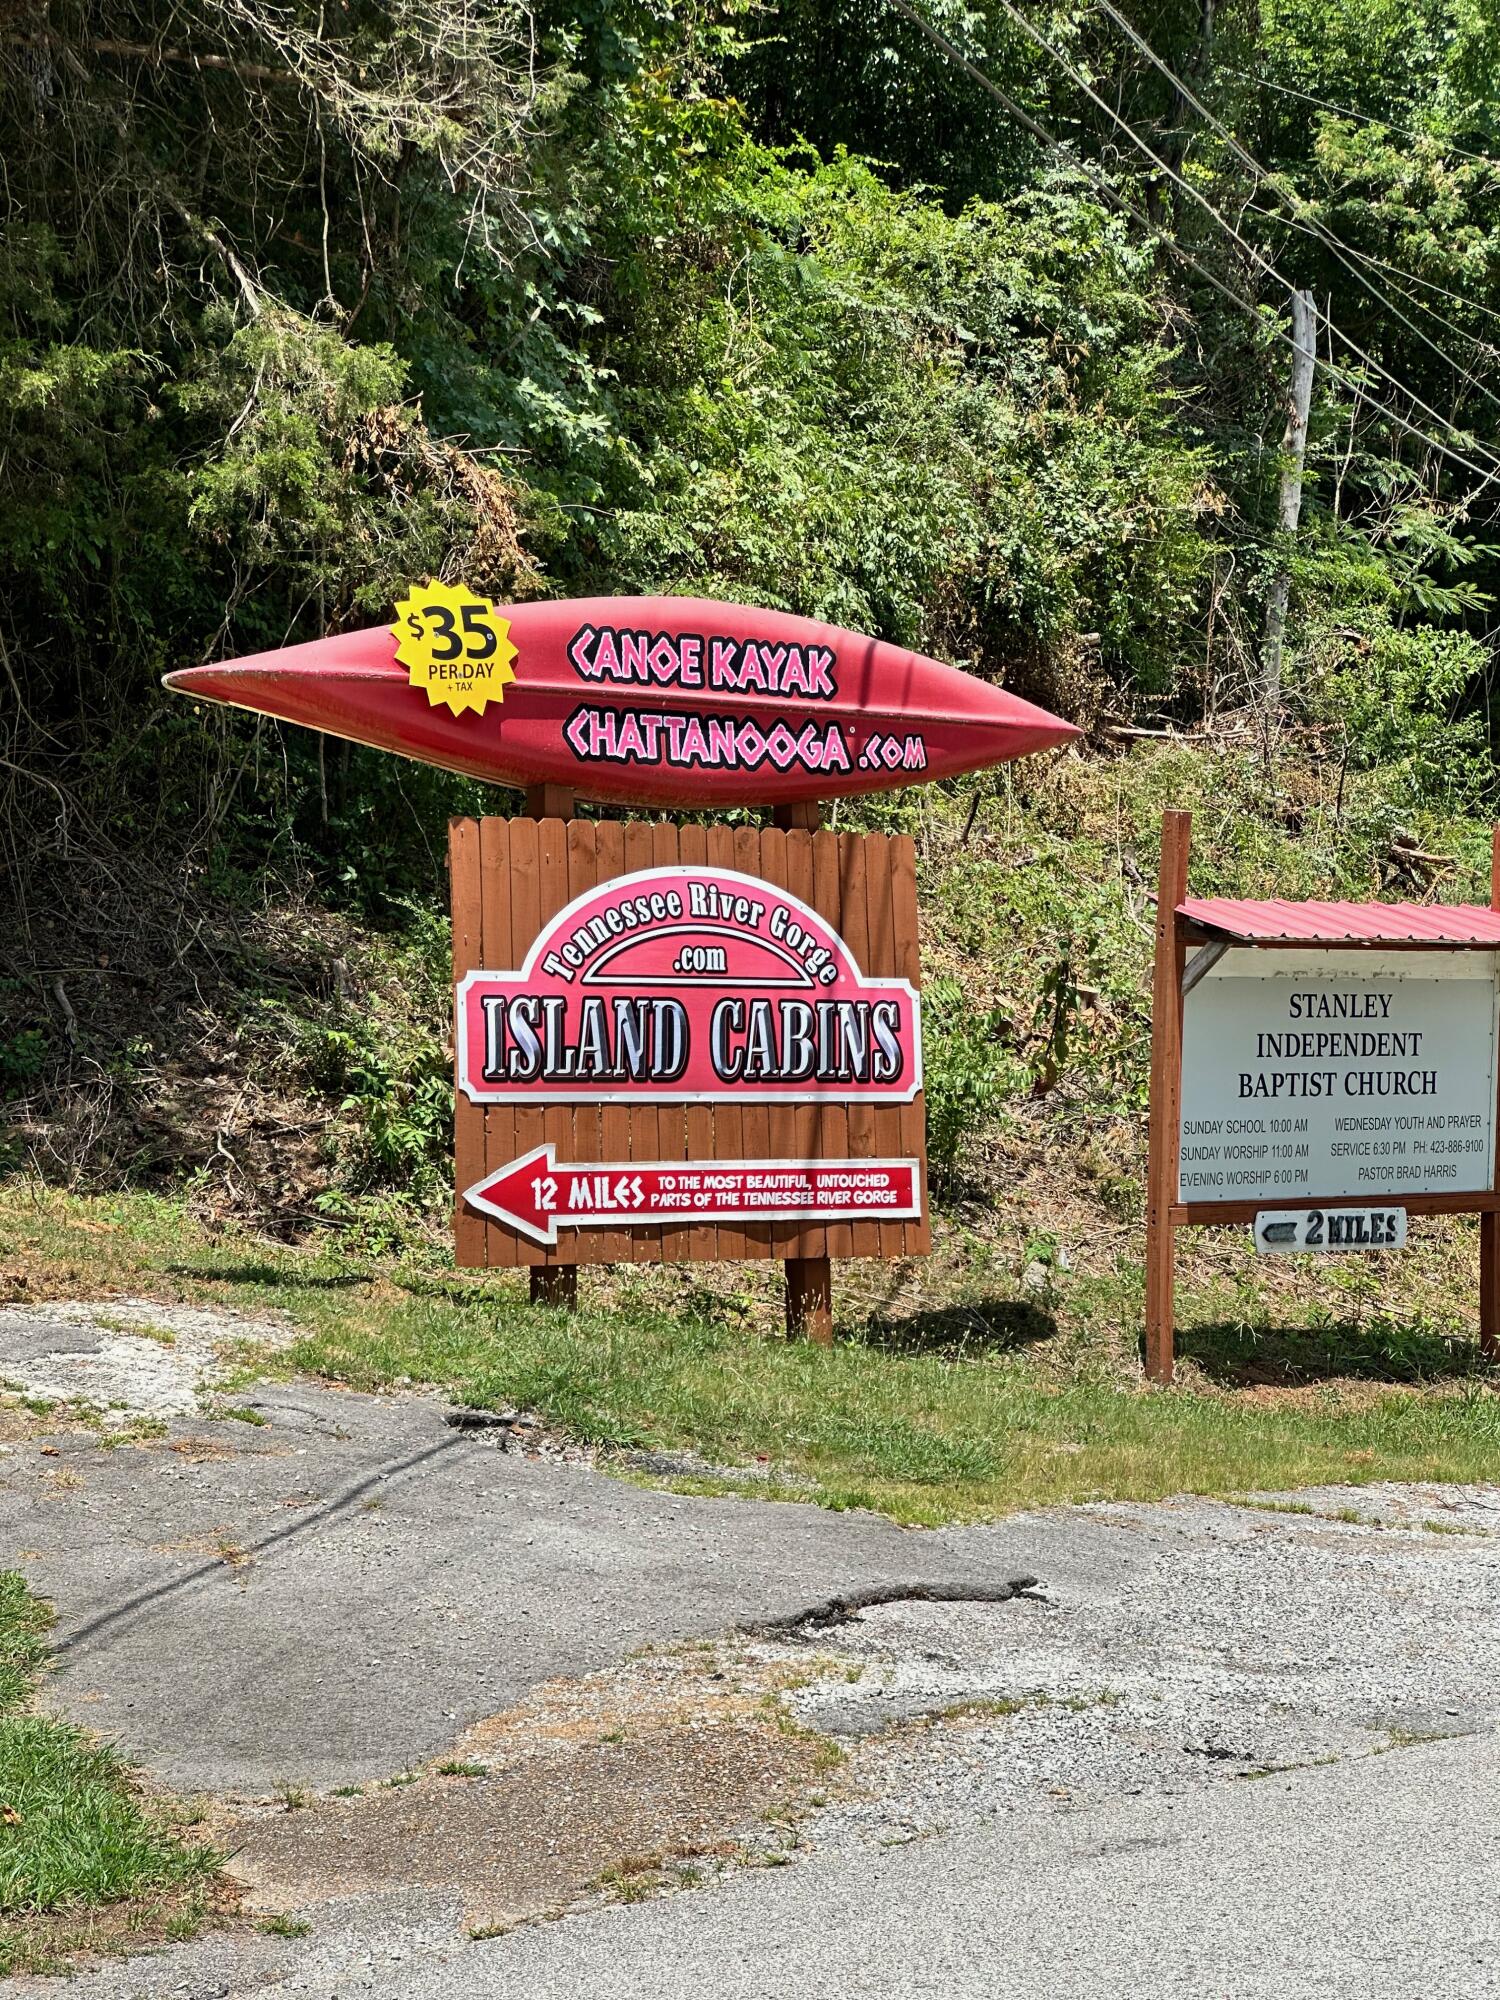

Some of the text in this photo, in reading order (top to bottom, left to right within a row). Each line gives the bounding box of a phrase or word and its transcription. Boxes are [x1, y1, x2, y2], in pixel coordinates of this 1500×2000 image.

[570, 628, 835, 695] CANOE KAYAK
[428, 663, 494, 679] PER DAY
[455, 682, 473, 691] TAX
[542, 882, 837, 985] Tennessee River Gorge
[673, 946, 726, 971] .com
[1289, 993, 1393, 1018] STANLEY
[482, 996, 902, 1082] ISLAND CABINS
[1256, 1032, 1423, 1058] INDEPENDENT
[1238, 1070, 1438, 1098] BAPTIST CHURCH
[1183, 1118, 1308, 1135] SUNDAY SCHOOL 10:00 AM
[1335, 1115, 1482, 1131] WEDNESDAY YOUTH AND PRAYER
[1180, 1144, 1309, 1160] SUNDAY WORSHIP 11:00 AM
[1330, 1141, 1406, 1156] SERVICE 6:30 PM
[1413, 1139, 1484, 1154] PH: 423-886-9100
[1180, 1169, 1308, 1186] EVENING WORSHIP 6:00 PM
[1358, 1164, 1457, 1180] PASTOR BRAD HARRIS
[658, 1174, 890, 1190] TO THE MOST BEAUTIFUL, UNTOUCHED
[531, 1176, 646, 1210] 12 MILES
[650, 1190, 897, 1207] PARTS OF THE TENNESSEE RIVER GORGE
[1304, 1211, 1399, 1244] 2 MILES
